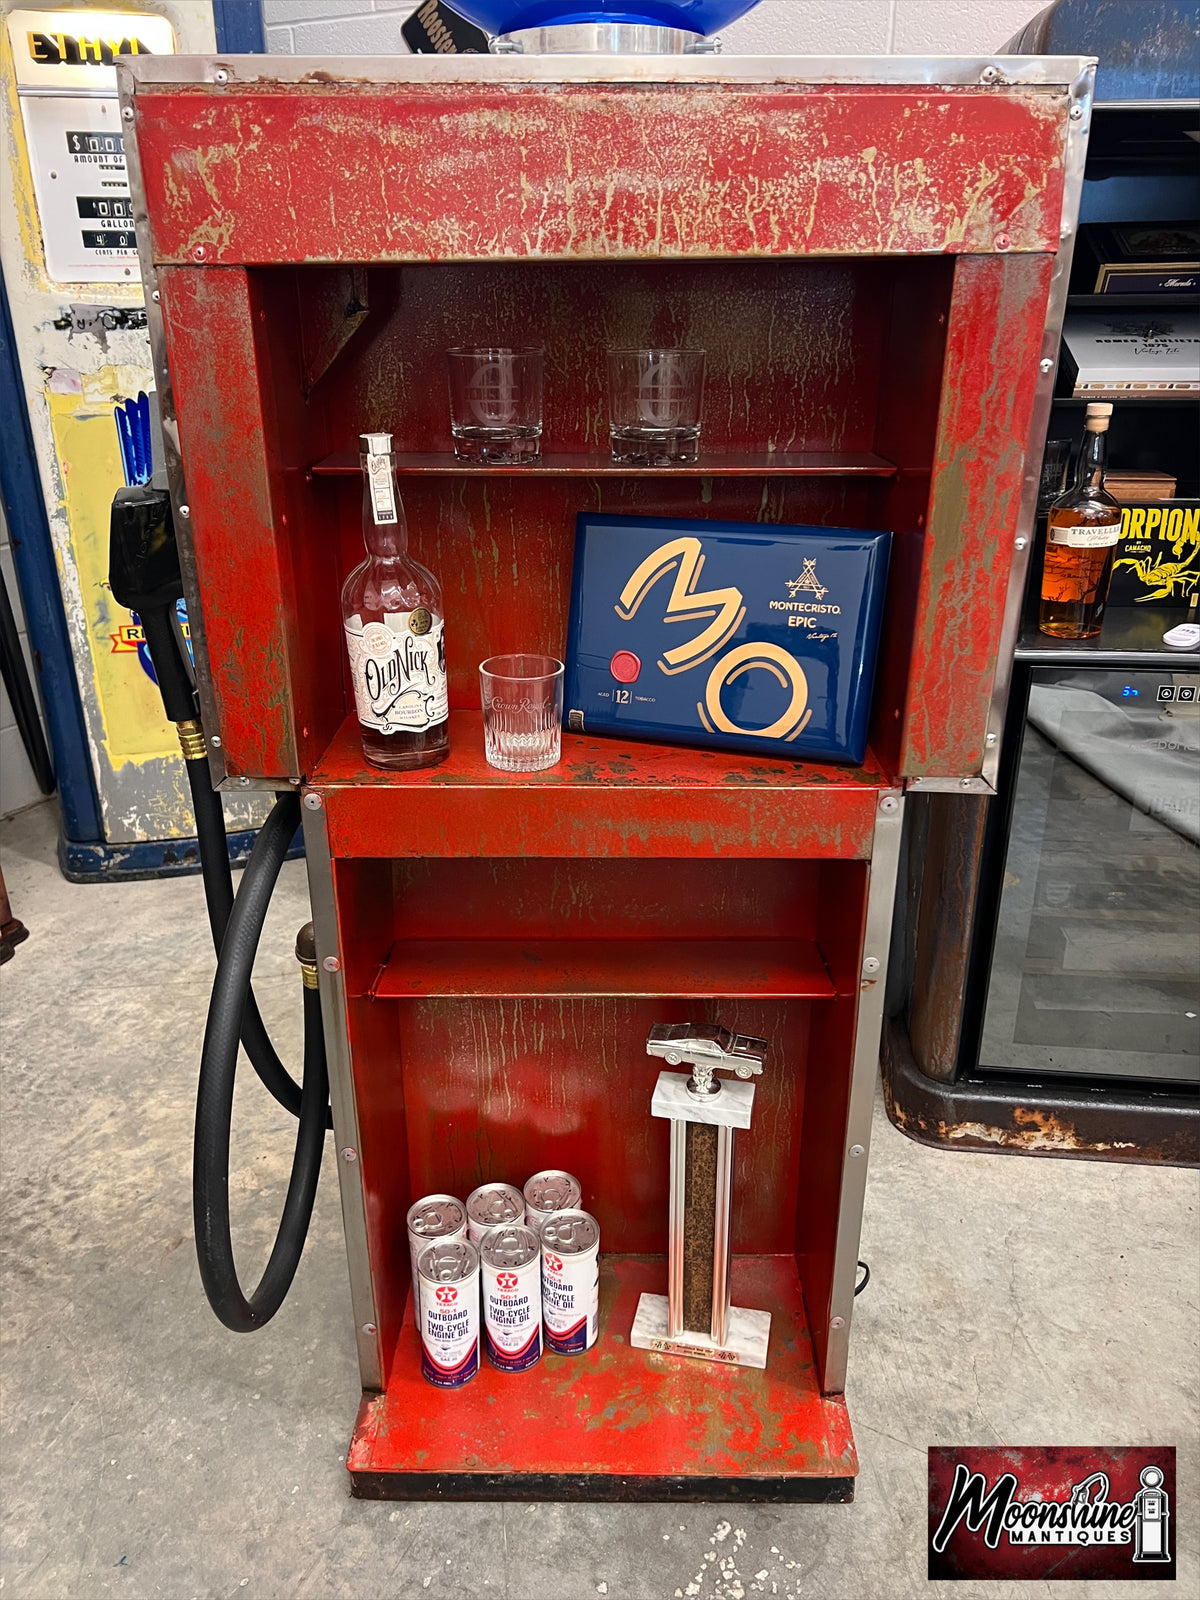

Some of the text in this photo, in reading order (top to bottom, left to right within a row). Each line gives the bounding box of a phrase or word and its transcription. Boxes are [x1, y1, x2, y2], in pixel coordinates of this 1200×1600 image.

[74, 155, 123, 163] AMOUNT OF
[788, 616, 817, 628] EPIC
[616, 689, 630, 704] 12
[491, 696, 518, 712] Crown
[394, 708, 424, 716] BOURBON
[490, 1295, 529, 1307] OUTBOARD
[562, 1301, 575, 1309] OIL
[428, 1309, 468, 1322] OUTBOARD
[489, 1305, 530, 1318] TWO-CYCLE
[490, 1313, 516, 1325] ENGINE
[519, 1313, 530, 1323] OIL
[427, 1319, 469, 1332] TWO-CYCLE
[428, 1326, 469, 1339] ENGINE OIL
